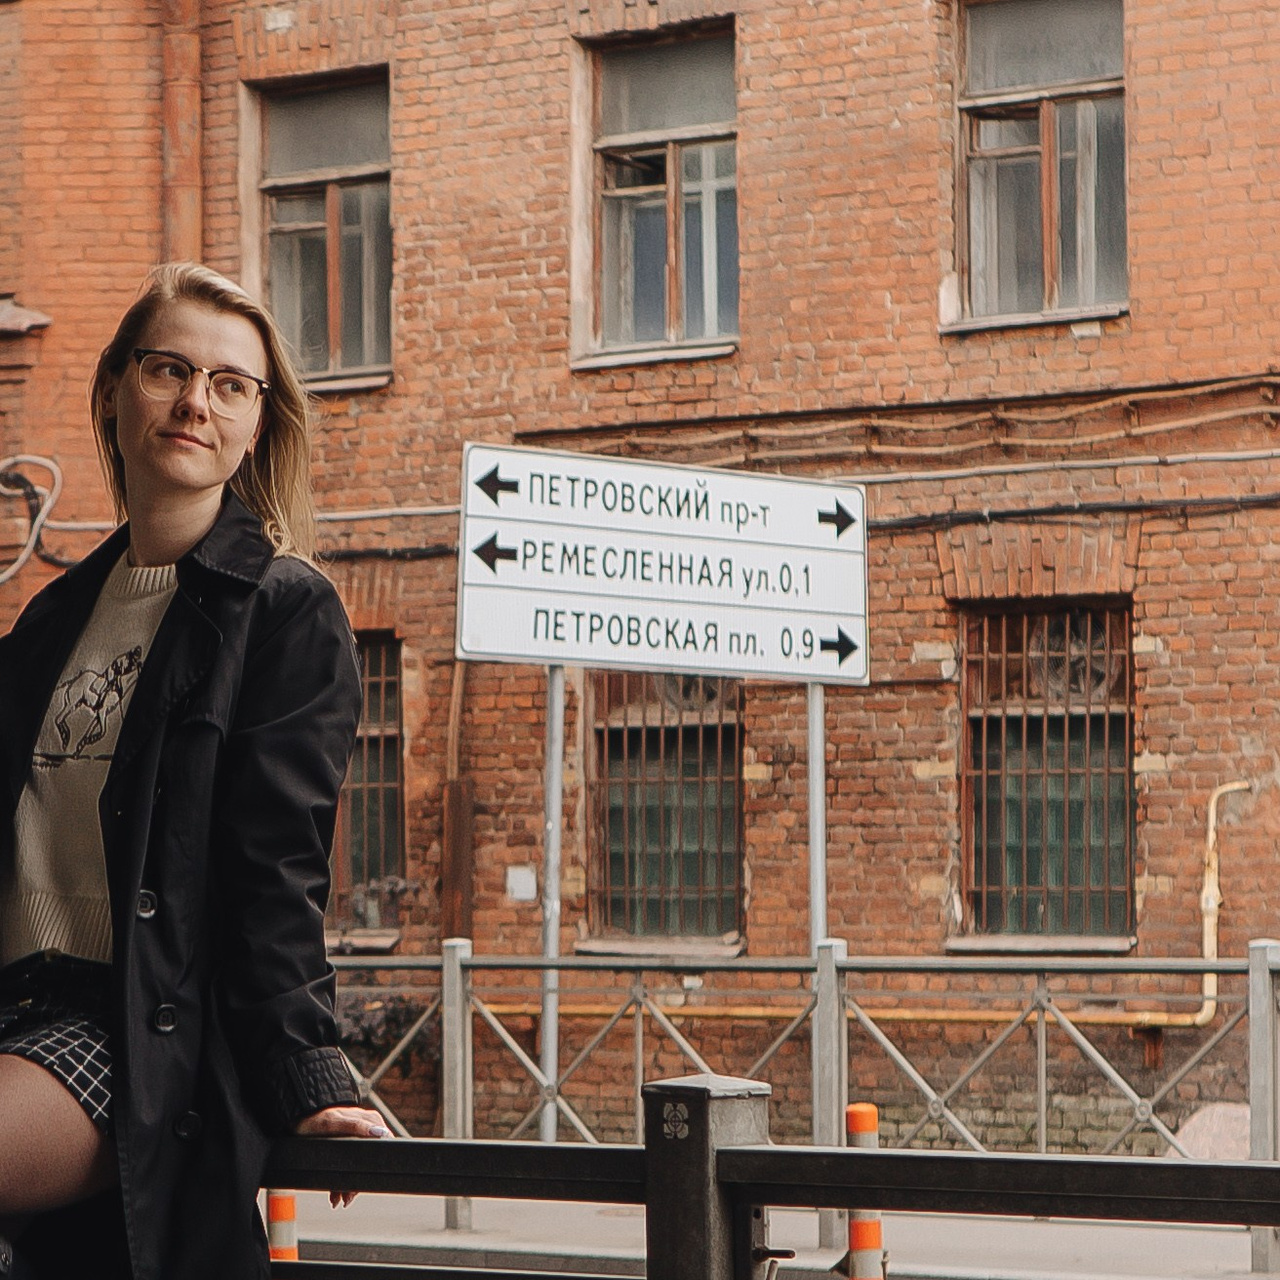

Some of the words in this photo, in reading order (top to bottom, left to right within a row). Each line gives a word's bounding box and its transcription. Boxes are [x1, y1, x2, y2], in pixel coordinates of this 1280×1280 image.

[528, 472, 711, 522] ПЕТРОВСКИЙ
[720, 499, 771, 533] пр-т
[521, 539, 733, 588] РЕМЕСЛЕННАЯ
[532, 607, 719, 652] ПЕТРОВСКАЯ
[728, 631, 766, 656] пл.
[780, 627, 815, 660] 0,9
